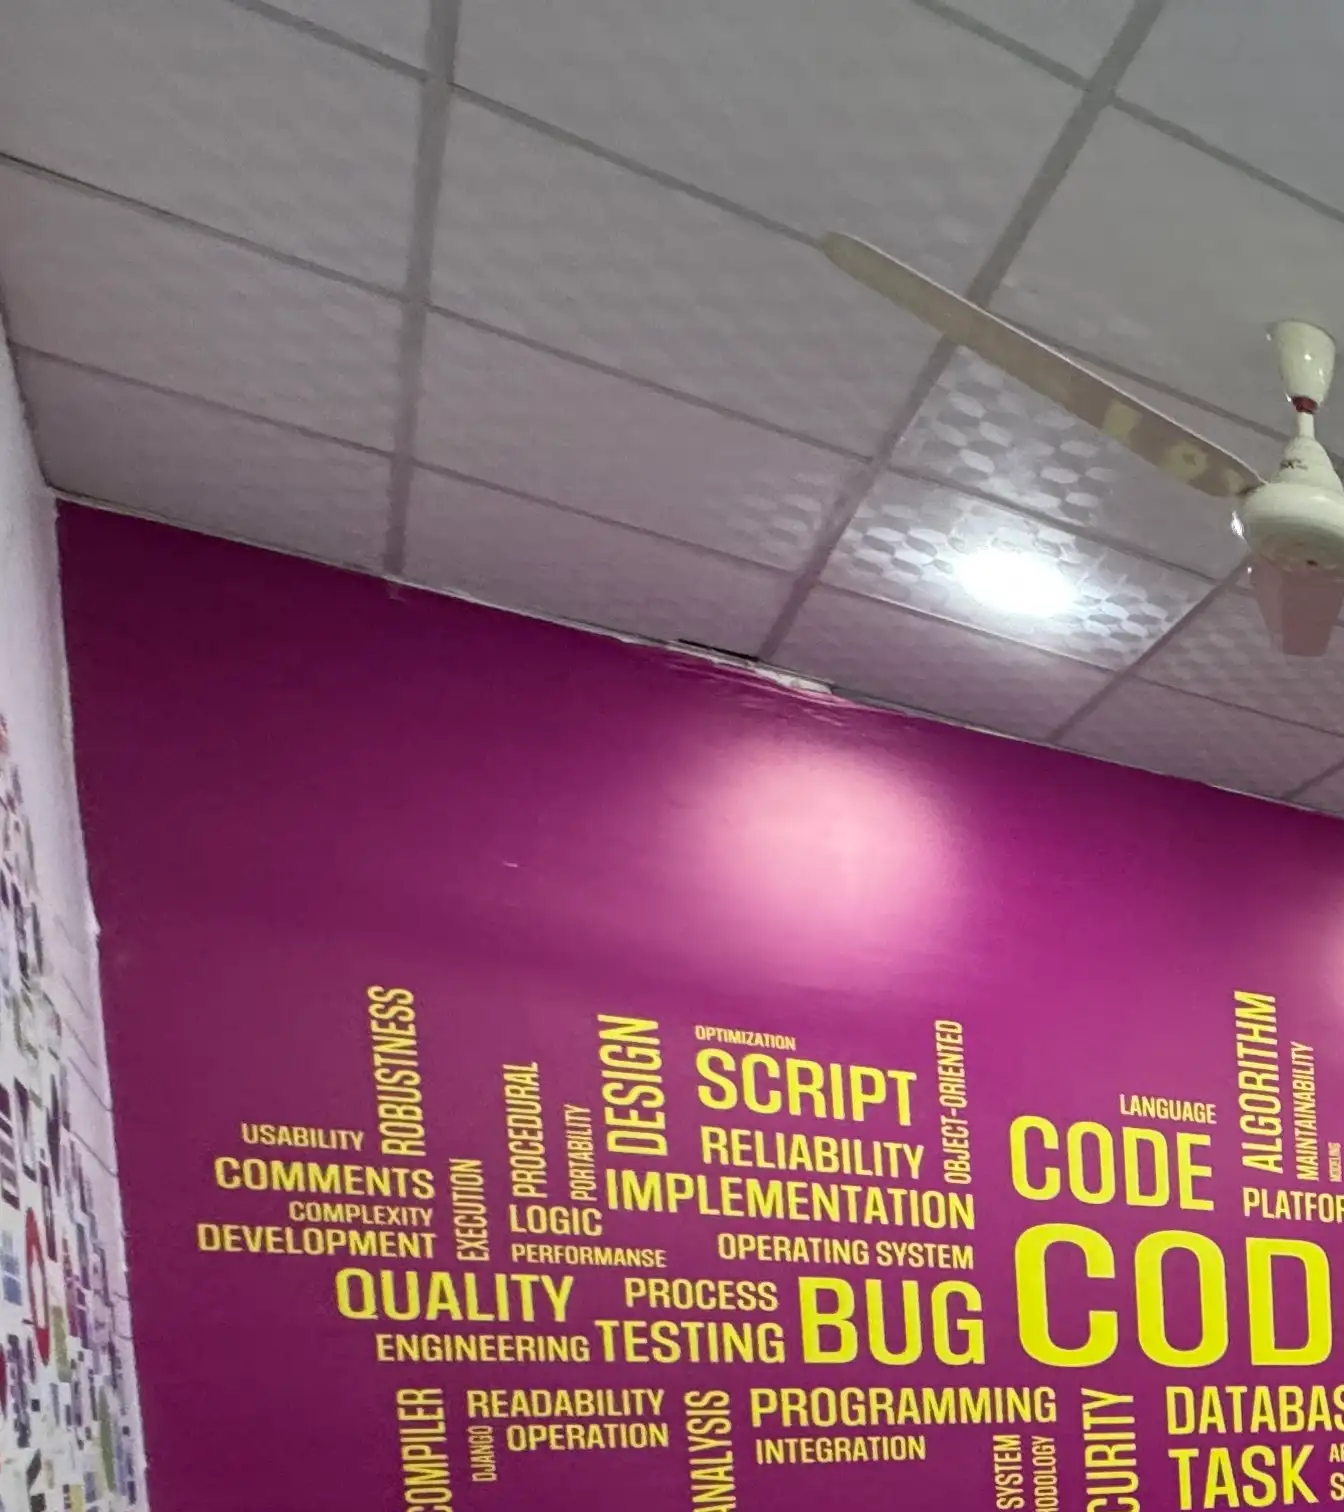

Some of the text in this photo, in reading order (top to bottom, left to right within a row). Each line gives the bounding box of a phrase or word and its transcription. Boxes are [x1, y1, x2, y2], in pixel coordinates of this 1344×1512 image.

[695, 1026, 796, 1050] OPTIMIZATION
[367, 986, 425, 1156] ROBUSTNESS
[598, 1015, 667, 1156] DESIGN
[696, 1048, 916, 1126] SCRIPT
[1234, 991, 1283, 1173] ALGORITHM
[935, 1020, 971, 1184] OBJECT-ORIENTED
[1120, 1095, 1215, 1124] LANGUAGE
[1291, 1042, 1318, 1180] MAINTAINABILITY
[242, 1124, 363, 1151] USABILITY
[504, 1063, 547, 1198] PROCEDURAL
[564, 1104, 596, 1201] PORTABILITY
[701, 1126, 923, 1178] RELIABILITY
[215, 1157, 435, 1199] COMMENTS
[1010, 1116, 1214, 1210] CODE
[289, 1201, 432, 1226] COMPLEXITY
[450, 1159, 489, 1261] EXECUTION
[509, 1204, 602, 1236] LOGIC
[606, 1168, 975, 1229] IMPLEMENTATION
[197, 1224, 435, 1258] DEVELOPMENT
[511, 1244, 665, 1267] PERFORMANSE
[718, 1233, 974, 1269] OPERATING SYSTEM
[336, 1268, 573, 1322] QUALITY
[625, 1277, 778, 1311] PROCESS
[595, 1320, 785, 1363] TESTING
[799, 1277, 984, 1365] BUG
[376, 1334, 590, 1362] ENGINEERING
[467, 1389, 664, 1418] READABILITY
[751, 1387, 1056, 1427] PROGRAMMING
[468, 1425, 496, 1481] DJANGO
[506, 1423, 669, 1451] OPERATION
[756, 1436, 926, 1464] INTEGRATION
[993, 1434, 1024, 1509] SYSTEM
[1168, 1445, 1317, 1510] TASK
